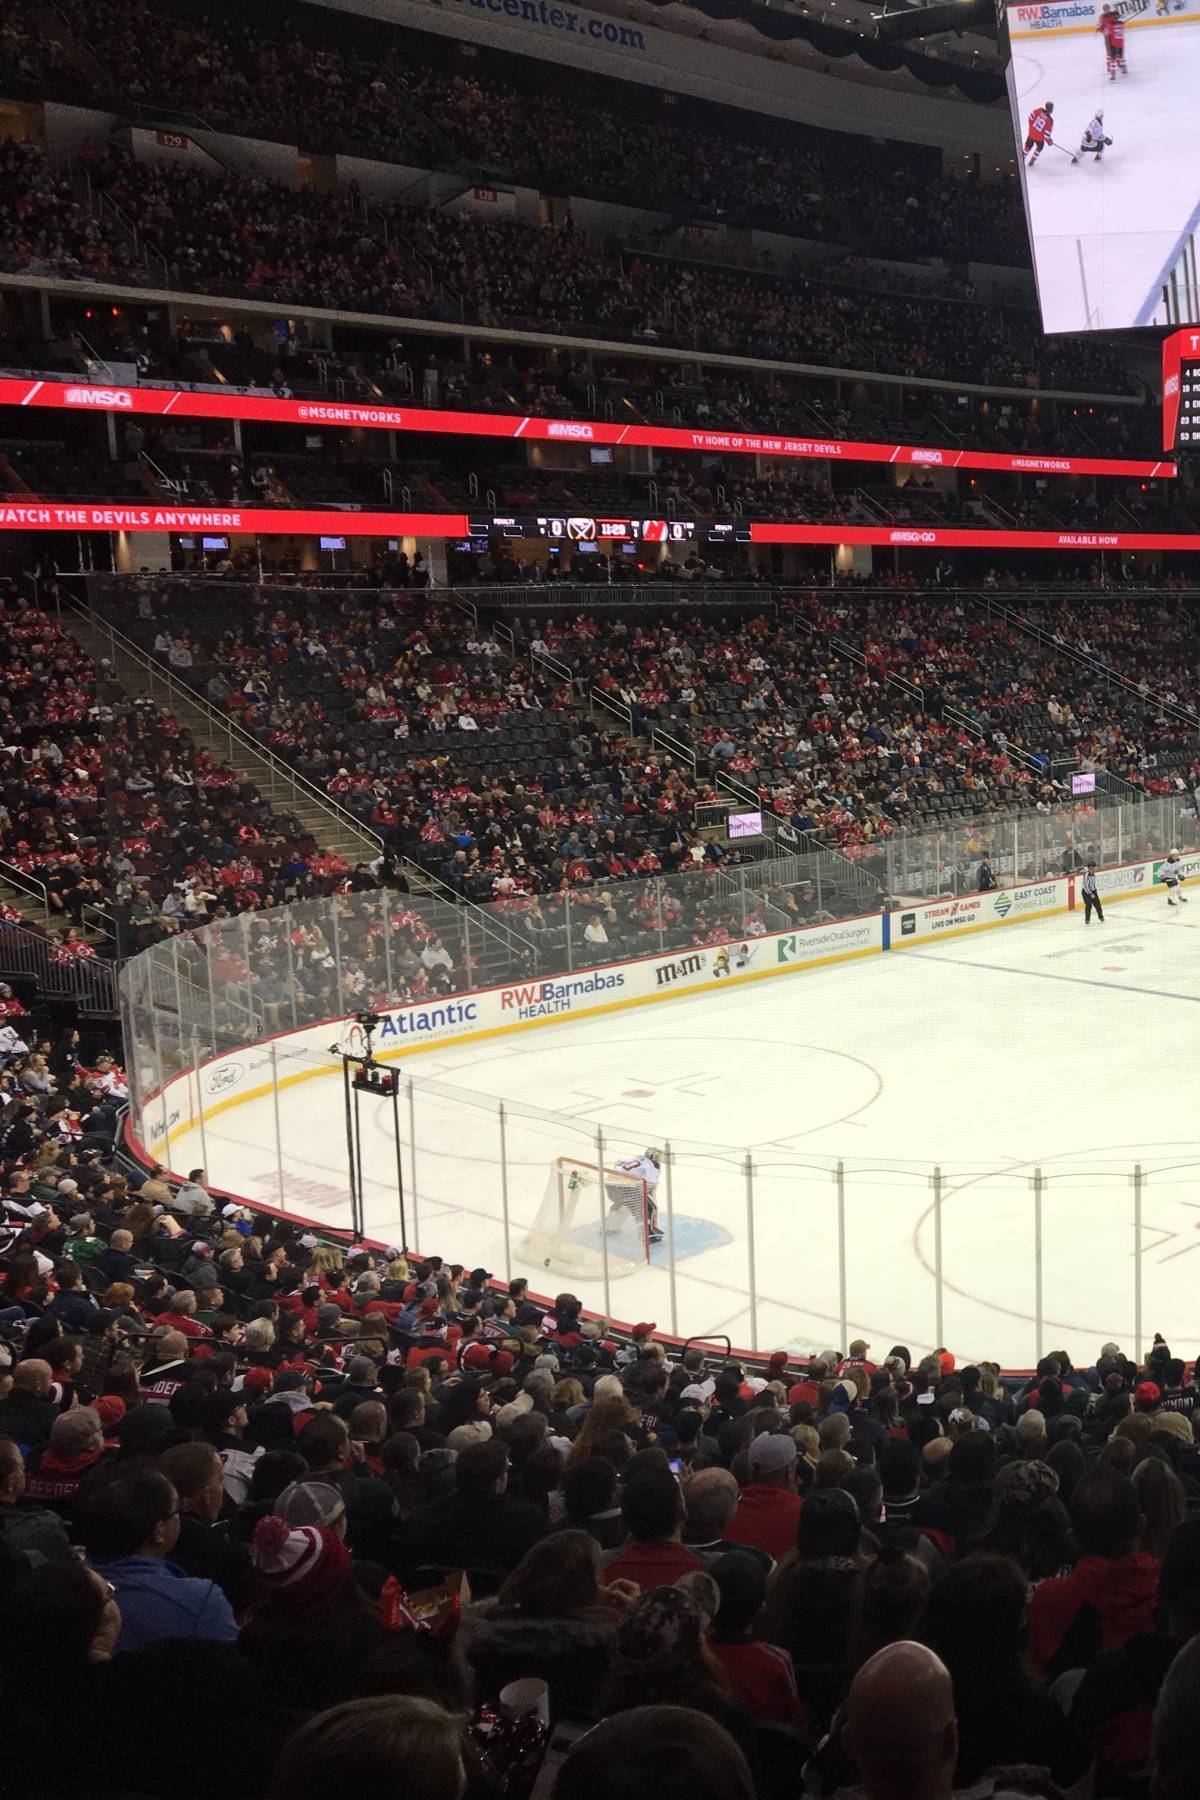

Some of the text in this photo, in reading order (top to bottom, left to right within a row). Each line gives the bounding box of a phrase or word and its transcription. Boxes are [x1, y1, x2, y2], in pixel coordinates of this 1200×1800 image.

[1030, 20, 1062, 29] HEALTH
[164, 135, 181, 147] 129
[78, 389, 132, 407] MSG
[298, 404, 401, 424] @MSGNETWORKS
[558, 424, 592, 439] MSG
[692, 434, 841, 454] TV HOME OF THE NEW JERSEY DEVILS
[918, 450, 942, 462] MSG
[1011, 459, 1070, 470] @MSGNETWORKS
[55, 509, 87, 524] THE
[93, 510, 150, 525] DEVILS
[154, 511, 241, 527] ANYWHERE
[552, 521, 561, 535] 0
[602, 524, 625, 535] 11:29
[672, 524, 682, 538] 0
[1058, 535, 1118, 545] AVAILABLE NOW
[1014, 885, 1056, 900] EAST COAST
[924, 901, 981, 920] STREAM GAMES
[931, 919, 944, 930] LIVE
[945, 918, 954, 927] ON
[501, 971, 625, 1010] RWJBarnabas
[519, 998, 571, 1020] HEALTH
[380, 999, 478, 1038] Atlantic
